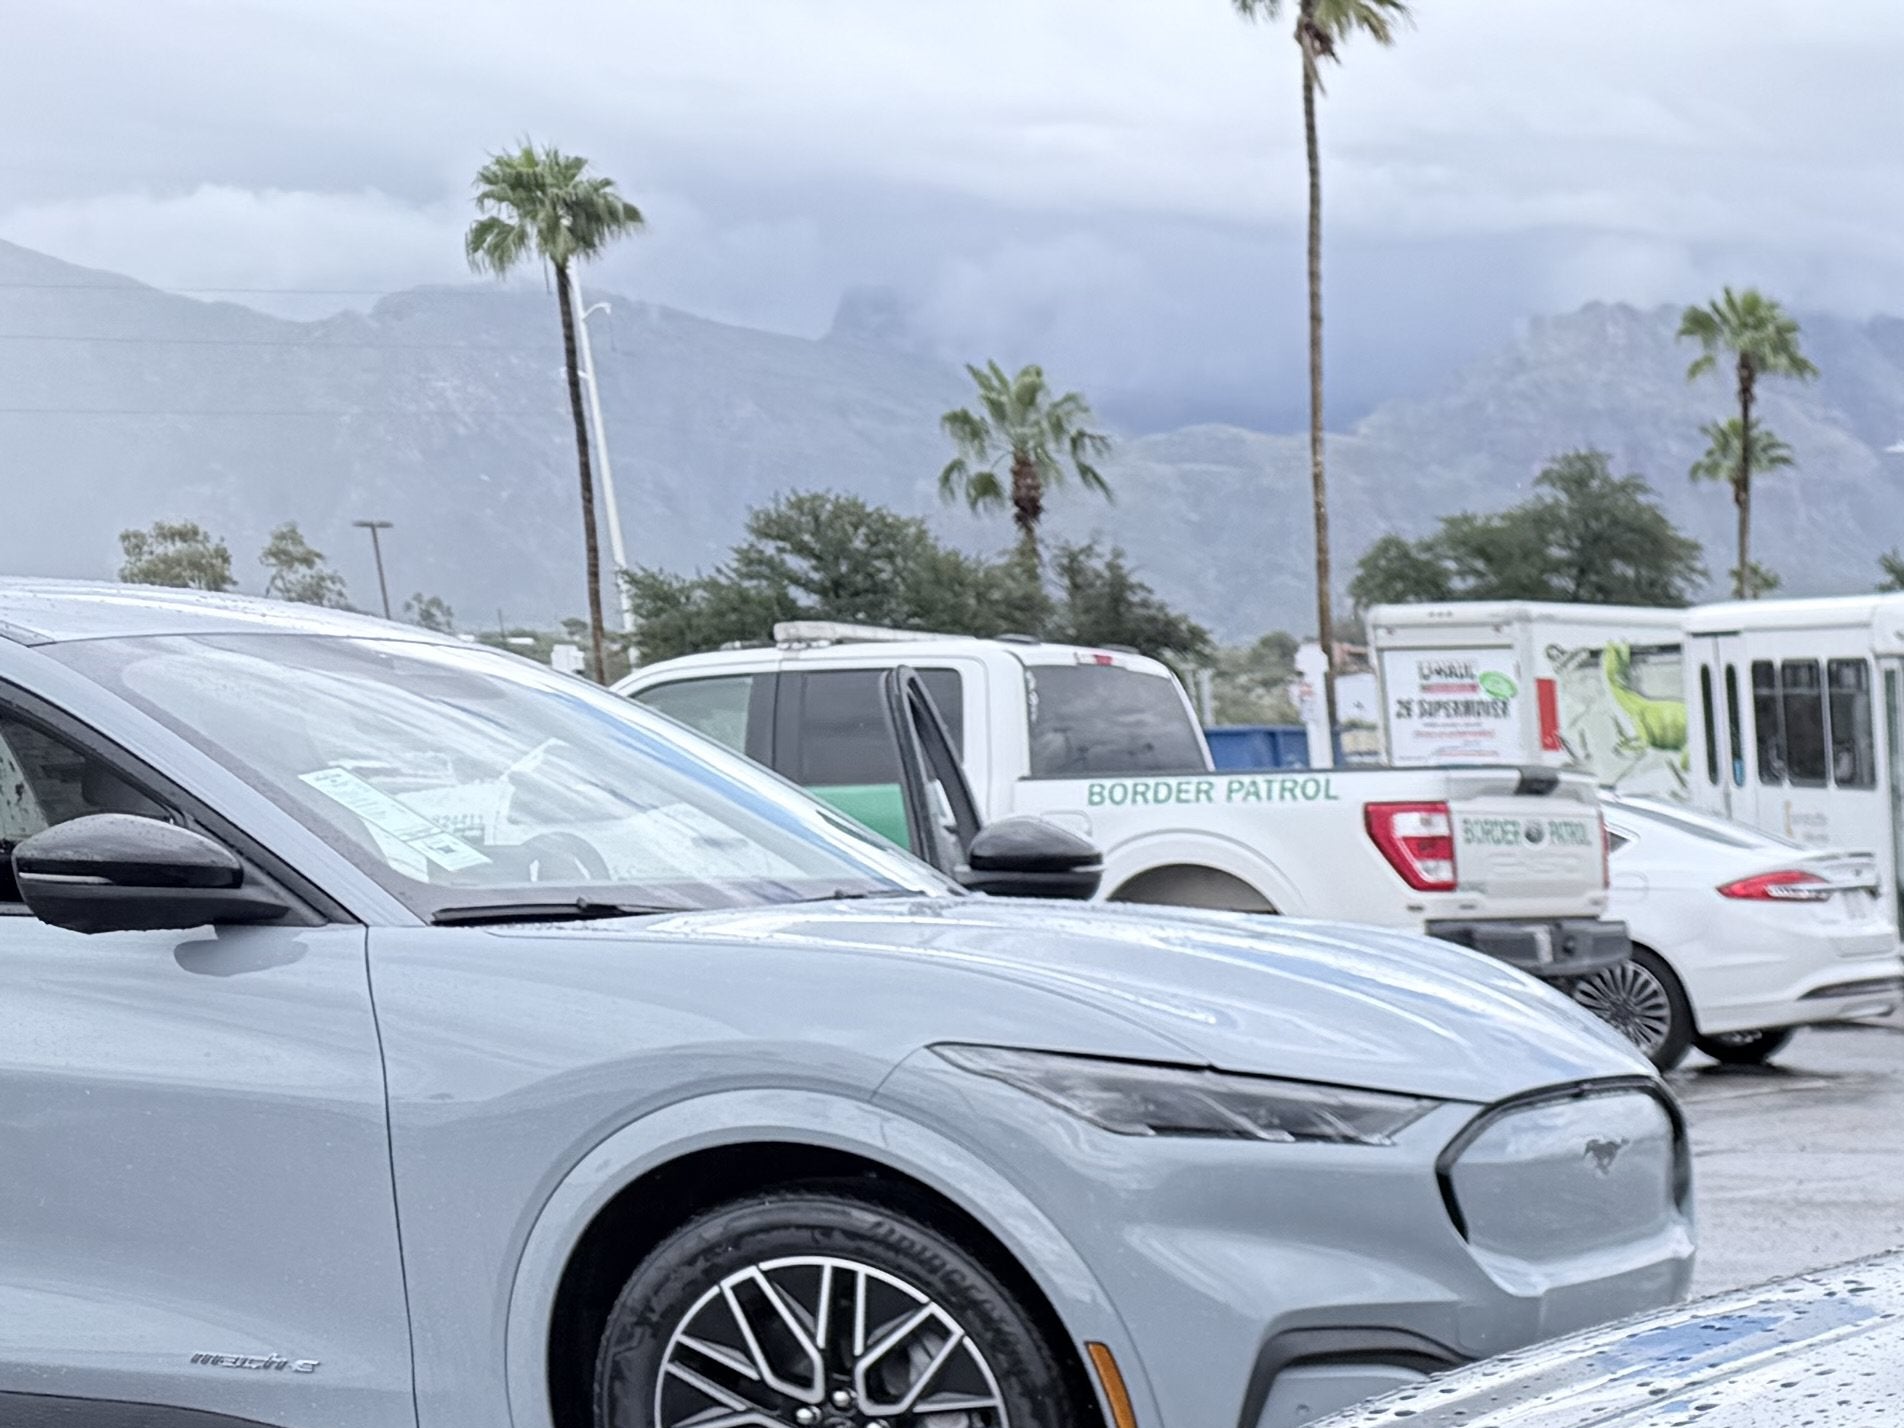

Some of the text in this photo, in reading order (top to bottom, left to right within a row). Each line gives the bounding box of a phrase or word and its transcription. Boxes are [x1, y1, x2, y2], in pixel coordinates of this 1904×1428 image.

[1088, 778, 1339, 806] BORDER PATROL
[1462, 818, 1592, 846] BORDER PATROL
